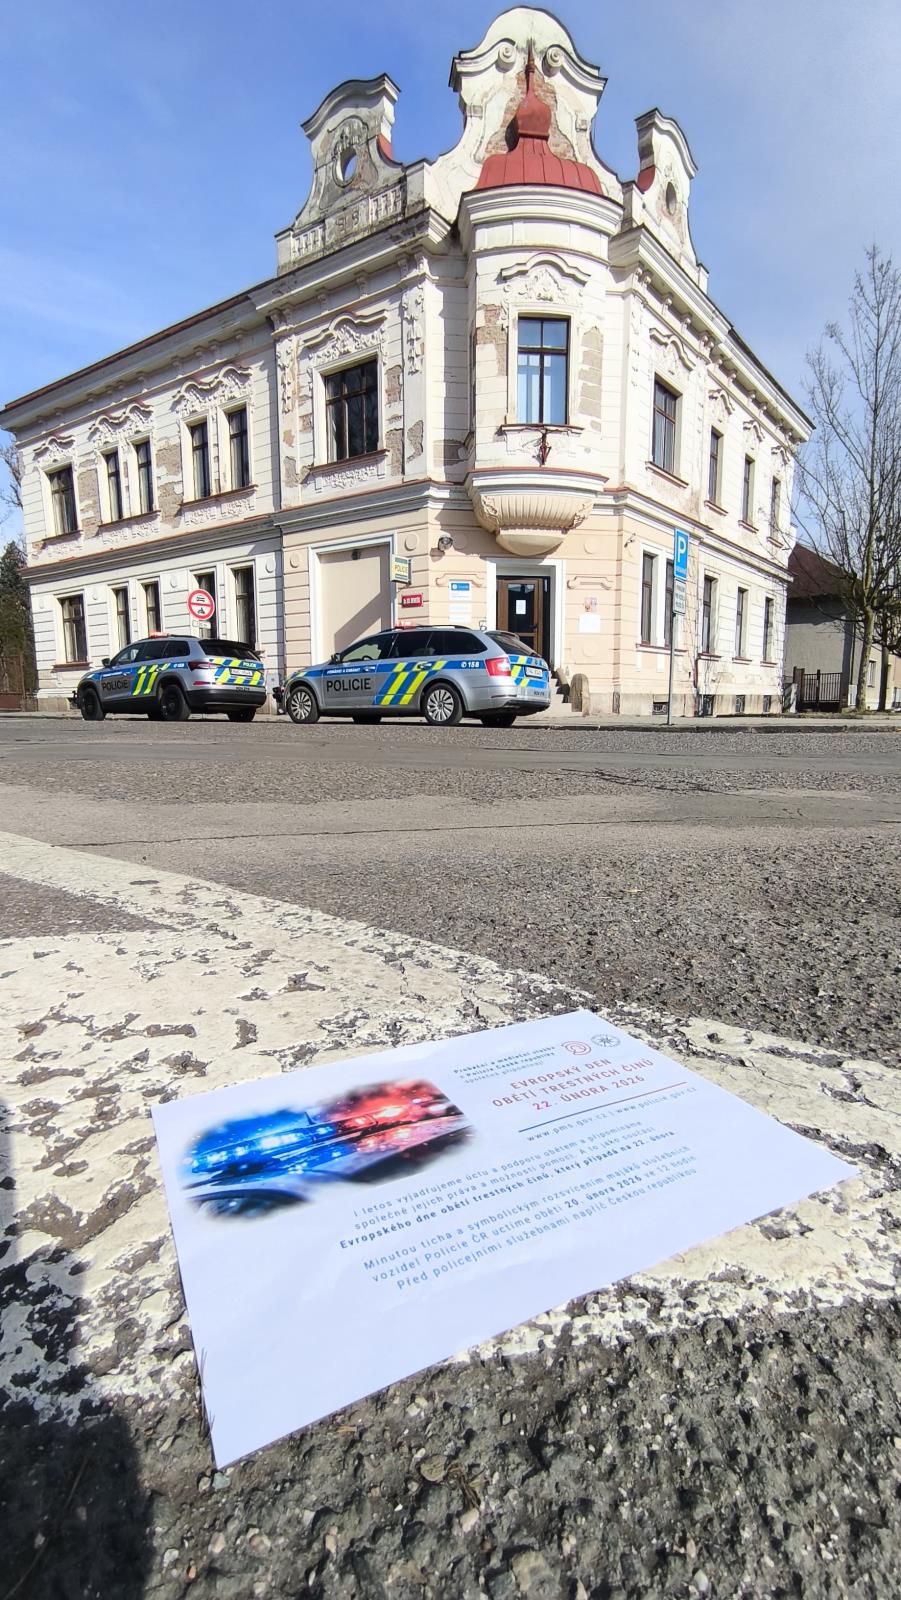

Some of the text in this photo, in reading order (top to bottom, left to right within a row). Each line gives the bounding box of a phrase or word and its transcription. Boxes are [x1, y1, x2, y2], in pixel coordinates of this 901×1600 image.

[678, 536, 686, 562] P
[102, 680, 128, 691] POLICIE
[326, 678, 371, 692] POLICIE
[510, 1058, 612, 1090] EVROPSKÝ DEN
[532, 1074, 646, 1110] 22. ÚNORA 2026
[540, 1069, 621, 1095] TRESTNÝCH
[622, 1058, 654, 1072] ČINŮ
[340, 1220, 412, 1249] Evropského
[416, 1212, 437, 1223] dne
[472, 1181, 524, 1202] trestných
[554, 1161, 581, 1174] který
[354, 1208, 408, 1230] společně
[412, 1196, 444, 1212] jejich
[447, 1184, 477, 1200] práva
[490, 1166, 536, 1184] možnosti
[362, 1200, 392, 1214] letos
[398, 1178, 462, 1204] vyjadřujeme
[500, 1154, 541, 1171] podporu
[364, 1246, 417, 1270] Minutou
[420, 1232, 452, 1248] ticha
[468, 1200, 540, 1231] symbolickým
[542, 1178, 604, 1202] rozsvícením
[372, 1258, 420, 1282] vozidel
[424, 1240, 469, 1262] Policie
[472, 1230, 489, 1243] ČR
[564, 1198, 584, 1208] 20.
[586, 1186, 616, 1200] února
[616, 1175, 642, 1188] 2026
[396, 1271, 428, 1290] Před
[432, 1242, 502, 1278] policejními
[506, 1215, 570, 1244] služebnami
